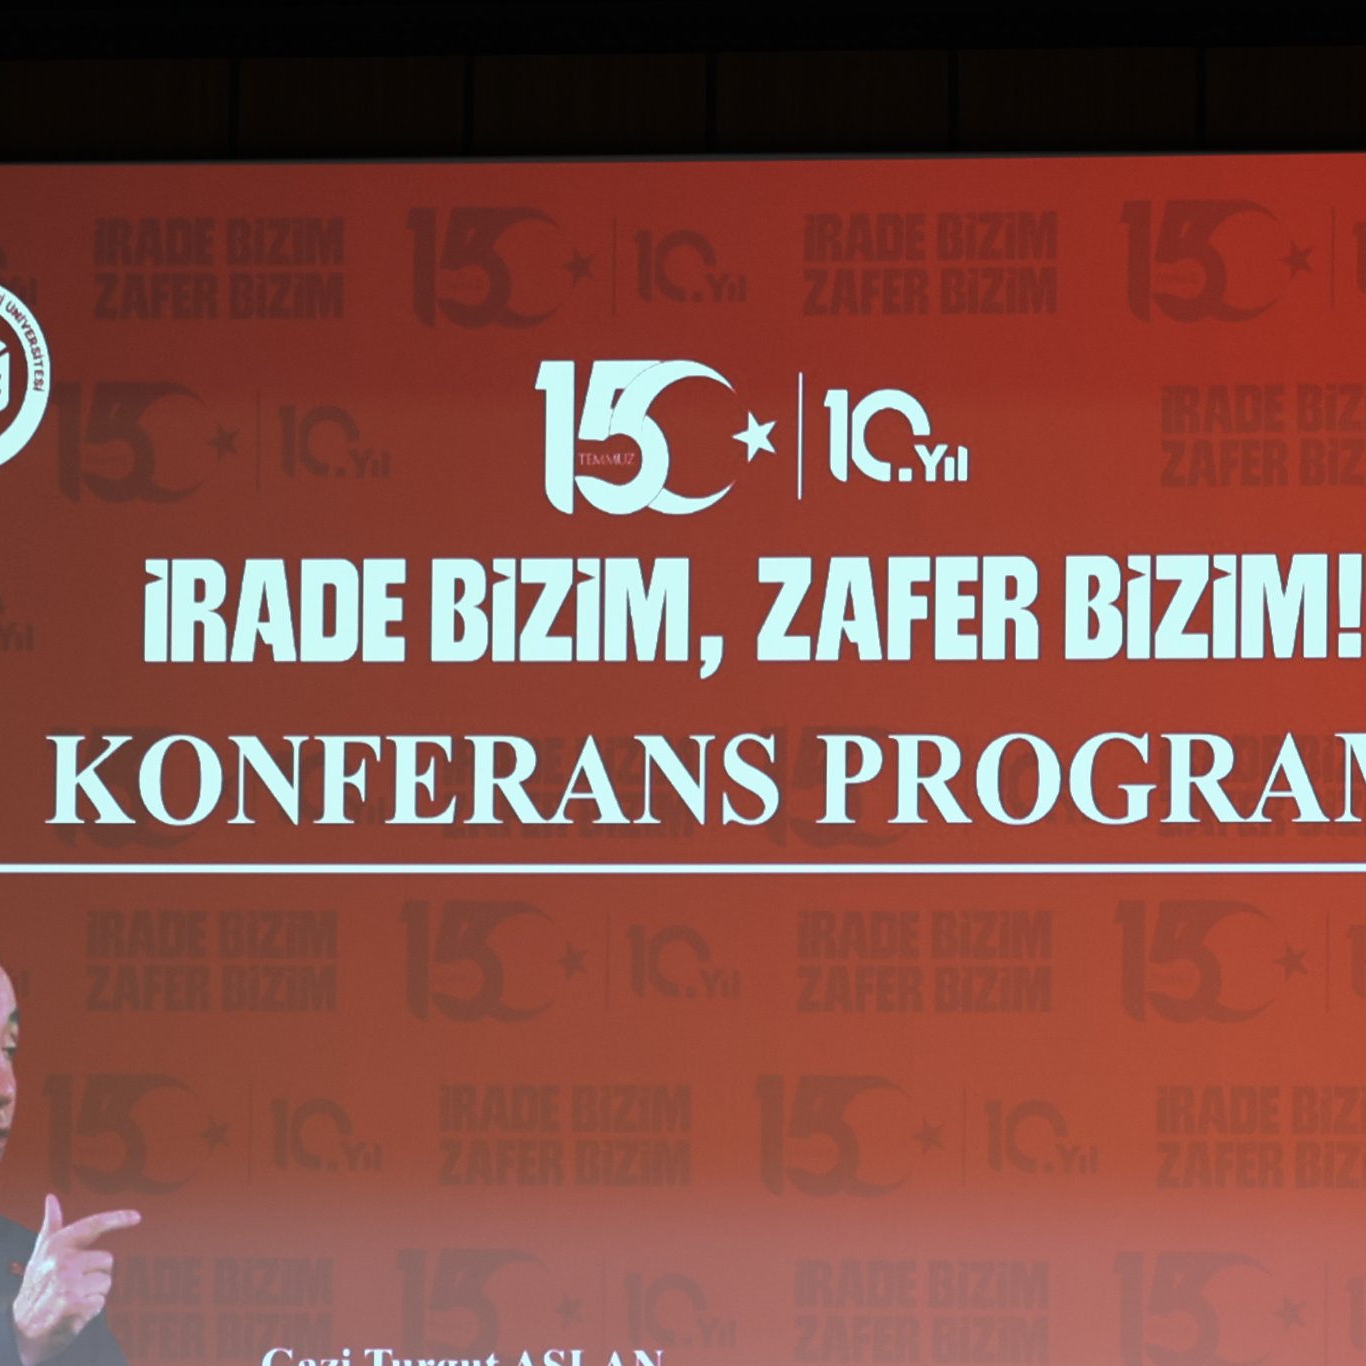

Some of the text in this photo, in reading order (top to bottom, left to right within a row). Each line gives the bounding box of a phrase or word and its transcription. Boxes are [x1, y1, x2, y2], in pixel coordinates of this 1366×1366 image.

[578, 452, 635, 466] TEMMUZ
[757, 556, 1039, 661] ZAFER
[45, 733, 780, 826] KONFERANS
